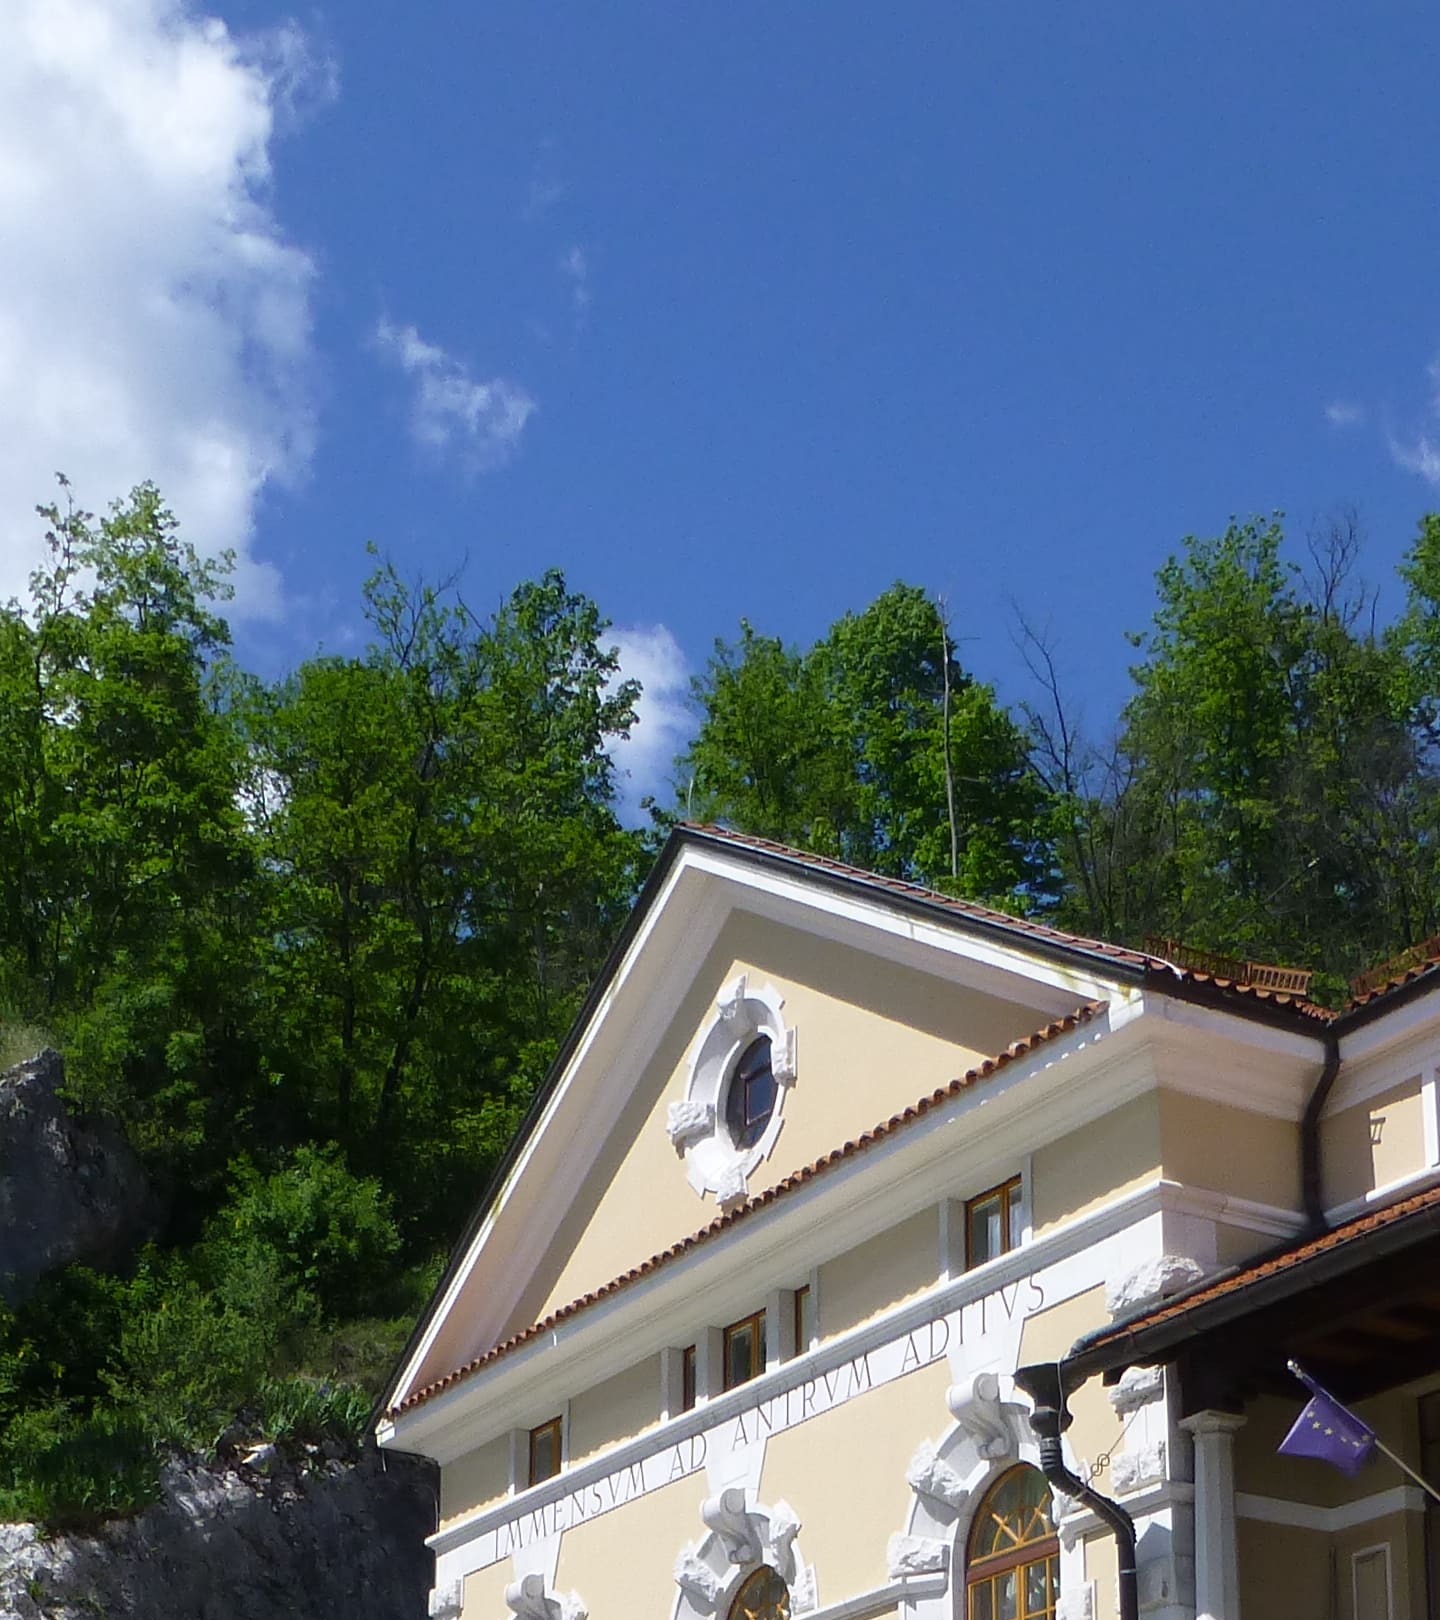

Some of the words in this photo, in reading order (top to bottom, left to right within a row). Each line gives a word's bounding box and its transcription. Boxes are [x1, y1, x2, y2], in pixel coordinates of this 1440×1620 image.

[494, 1460, 646, 1558] IMMENSVM
[669, 1432, 707, 1479] AD
[732, 1353, 873, 1451] ANTRVM
[901, 1271, 1044, 1372] ADITVS
